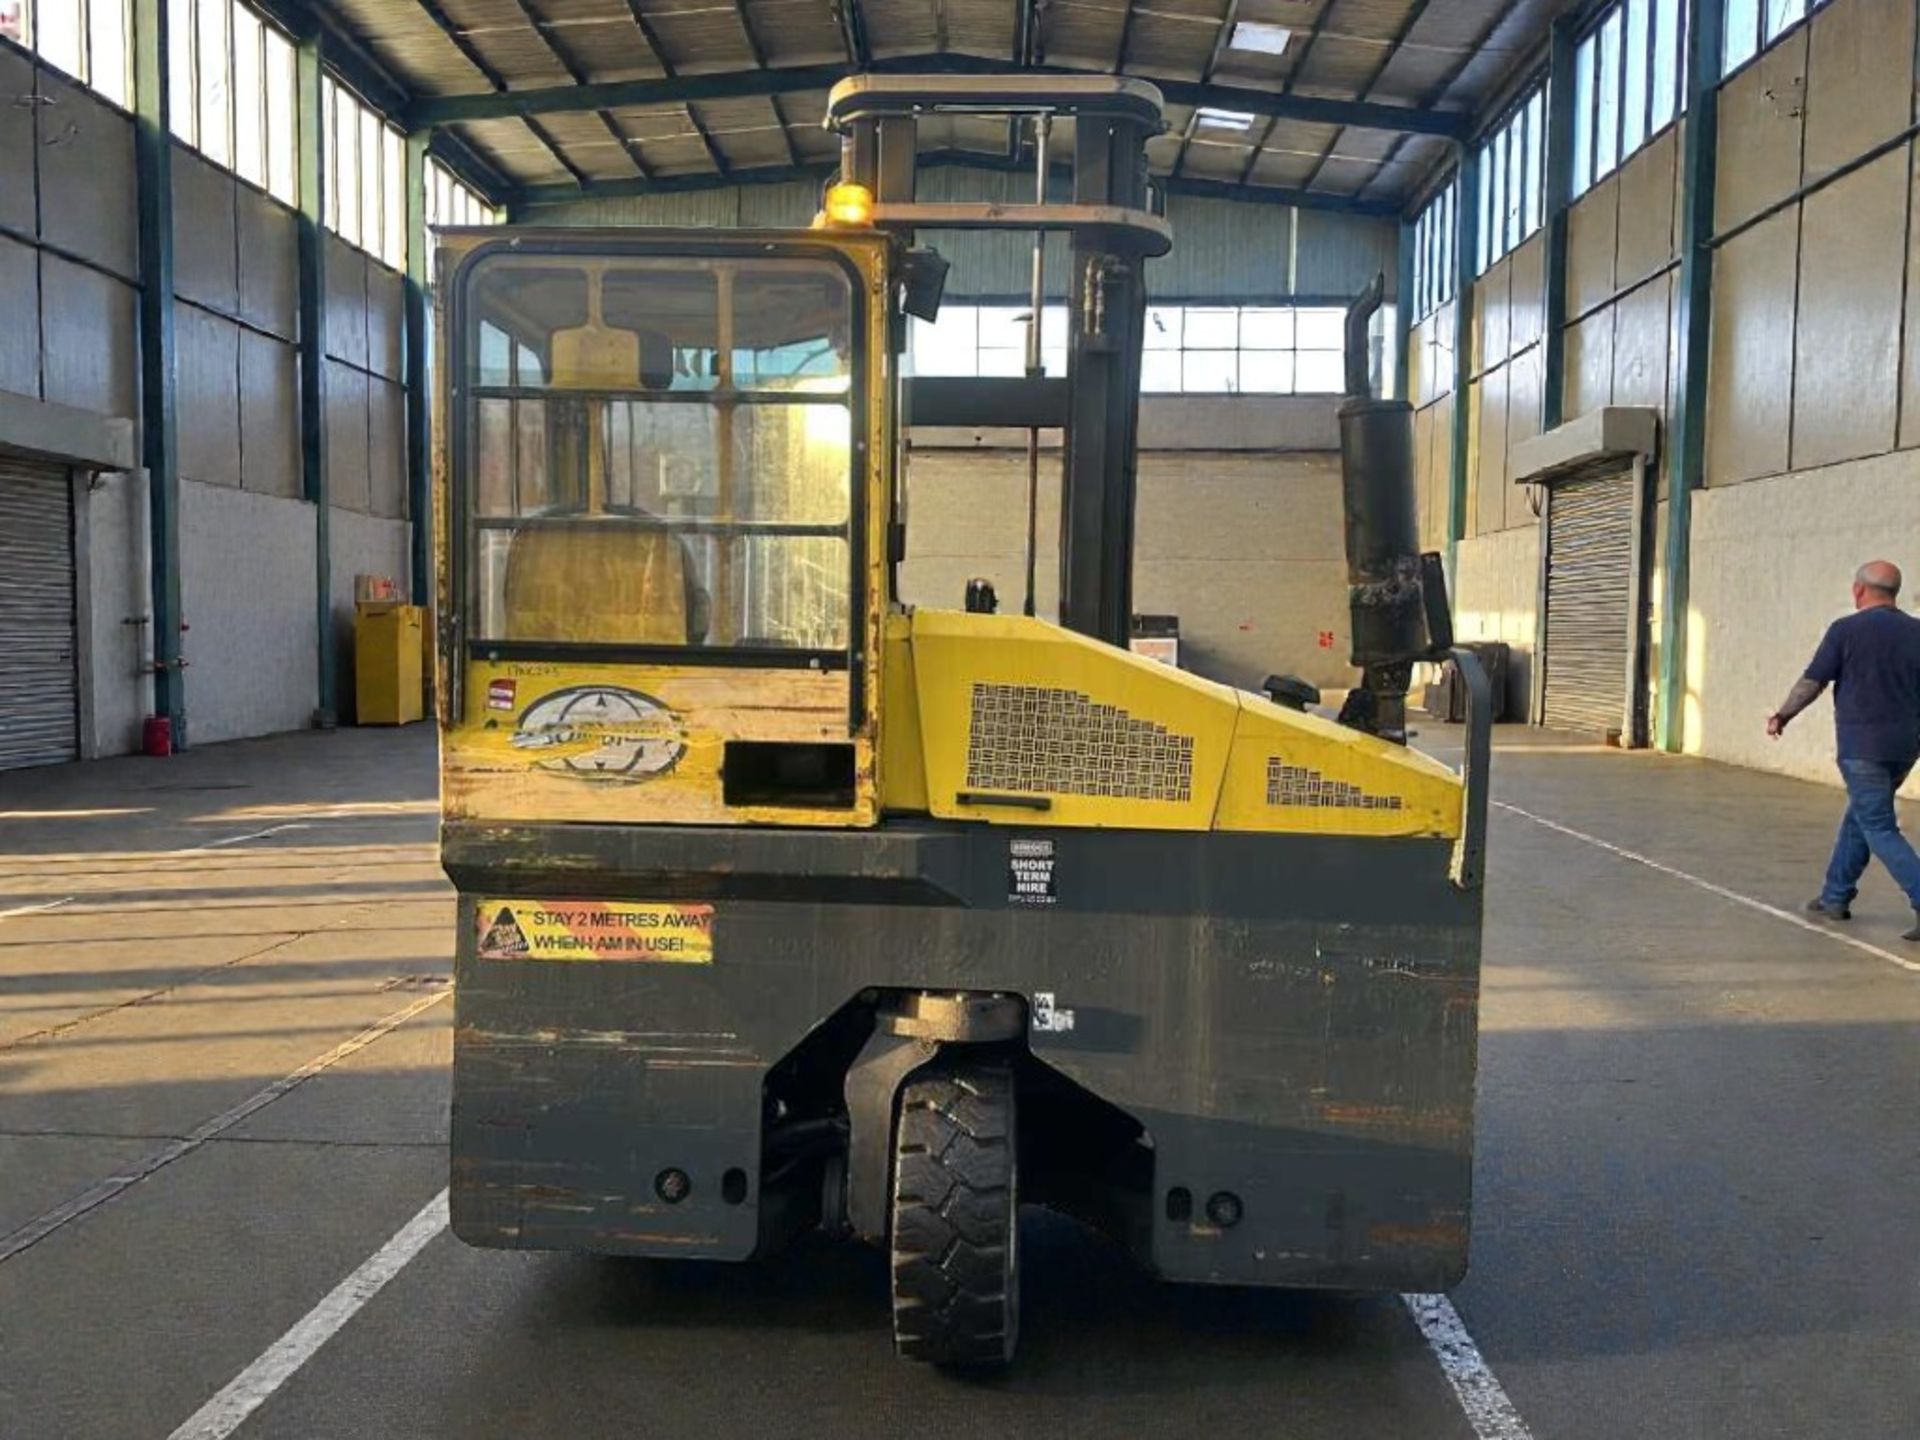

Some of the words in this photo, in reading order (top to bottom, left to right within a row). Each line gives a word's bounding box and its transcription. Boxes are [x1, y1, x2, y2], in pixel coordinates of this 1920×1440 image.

[1010, 859, 1055, 871] SHORT
[1014, 871, 1051, 882] TERM
[1016, 882, 1048, 893] HIRE
[533, 911, 573, 926] STAY
[578, 912, 587, 926] 2
[590, 912, 659, 928] METRES
[663, 913, 710, 928] AWAY
[533, 934, 585, 951] WHEN
[597, 936, 621, 951] AM
[625, 936, 642, 951] IN
[648, 937, 684, 952] USE!
